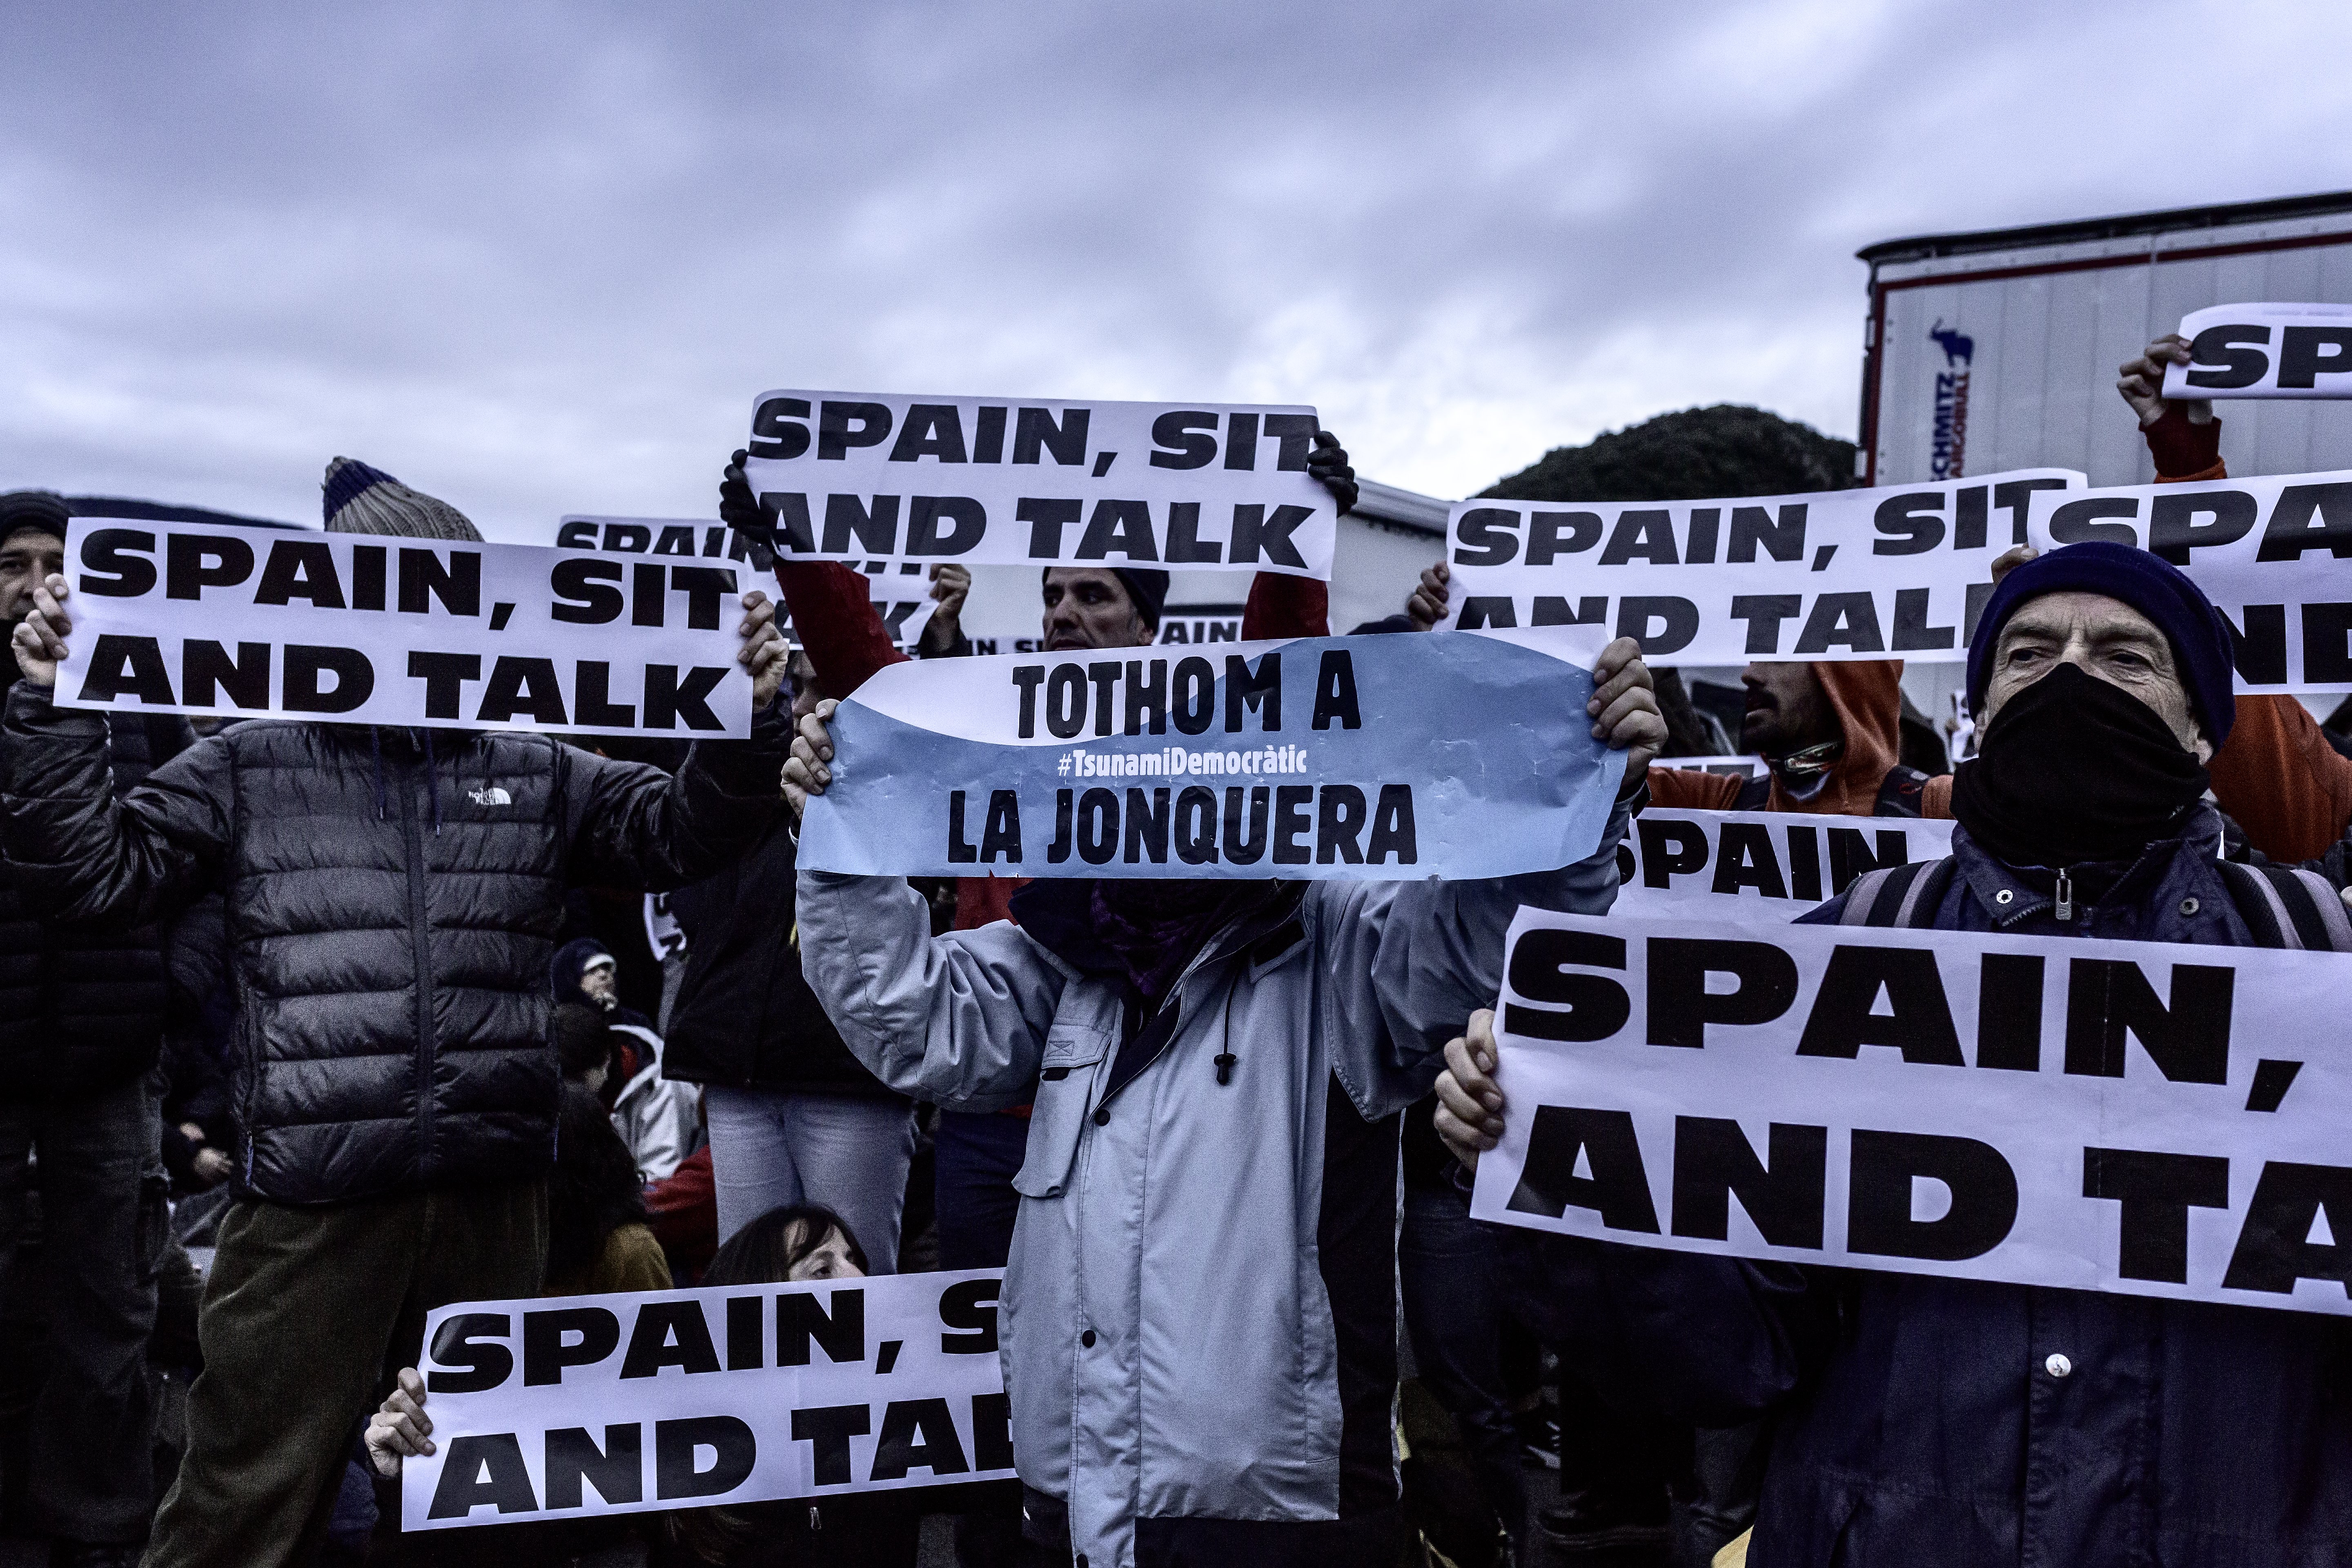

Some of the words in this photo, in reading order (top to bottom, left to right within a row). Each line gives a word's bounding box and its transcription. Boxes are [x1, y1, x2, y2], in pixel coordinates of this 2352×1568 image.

[748, 398, 1118, 477] SPAIN,
[1149, 411, 1321, 472] SIT
[758, 492, 987, 557] AND
[1016, 497, 1316, 570] TALK
[1454, 503, 1839, 571] SPAIN,
[1873, 479, 2067, 555] SIT
[79, 529, 516, 630] SPAIN,
[550, 558, 738, 630] SIT
[1160, 622, 1238, 645] AIN
[78, 634, 374, 713] AND
[408, 650, 731, 731] TALK
[1012, 653, 1281, 739] TOTHOM
[1311, 650, 1362, 731] A
[1057, 744, 1308, 777] #TsunamiDemocràtic
[947, 789, 1022, 864] LA
[1047, 784, 1418, 864] JONQUERA
[1619, 818, 1908, 902] PAIN
[1504, 929, 2305, 1113] SPAIN,
[1506, 1104, 2019, 1262] AND
[428, 1288, 904, 1394] SPAIN,
[427, 1415, 756, 1520] AND
[791, 1392, 1016, 1486] TAL
